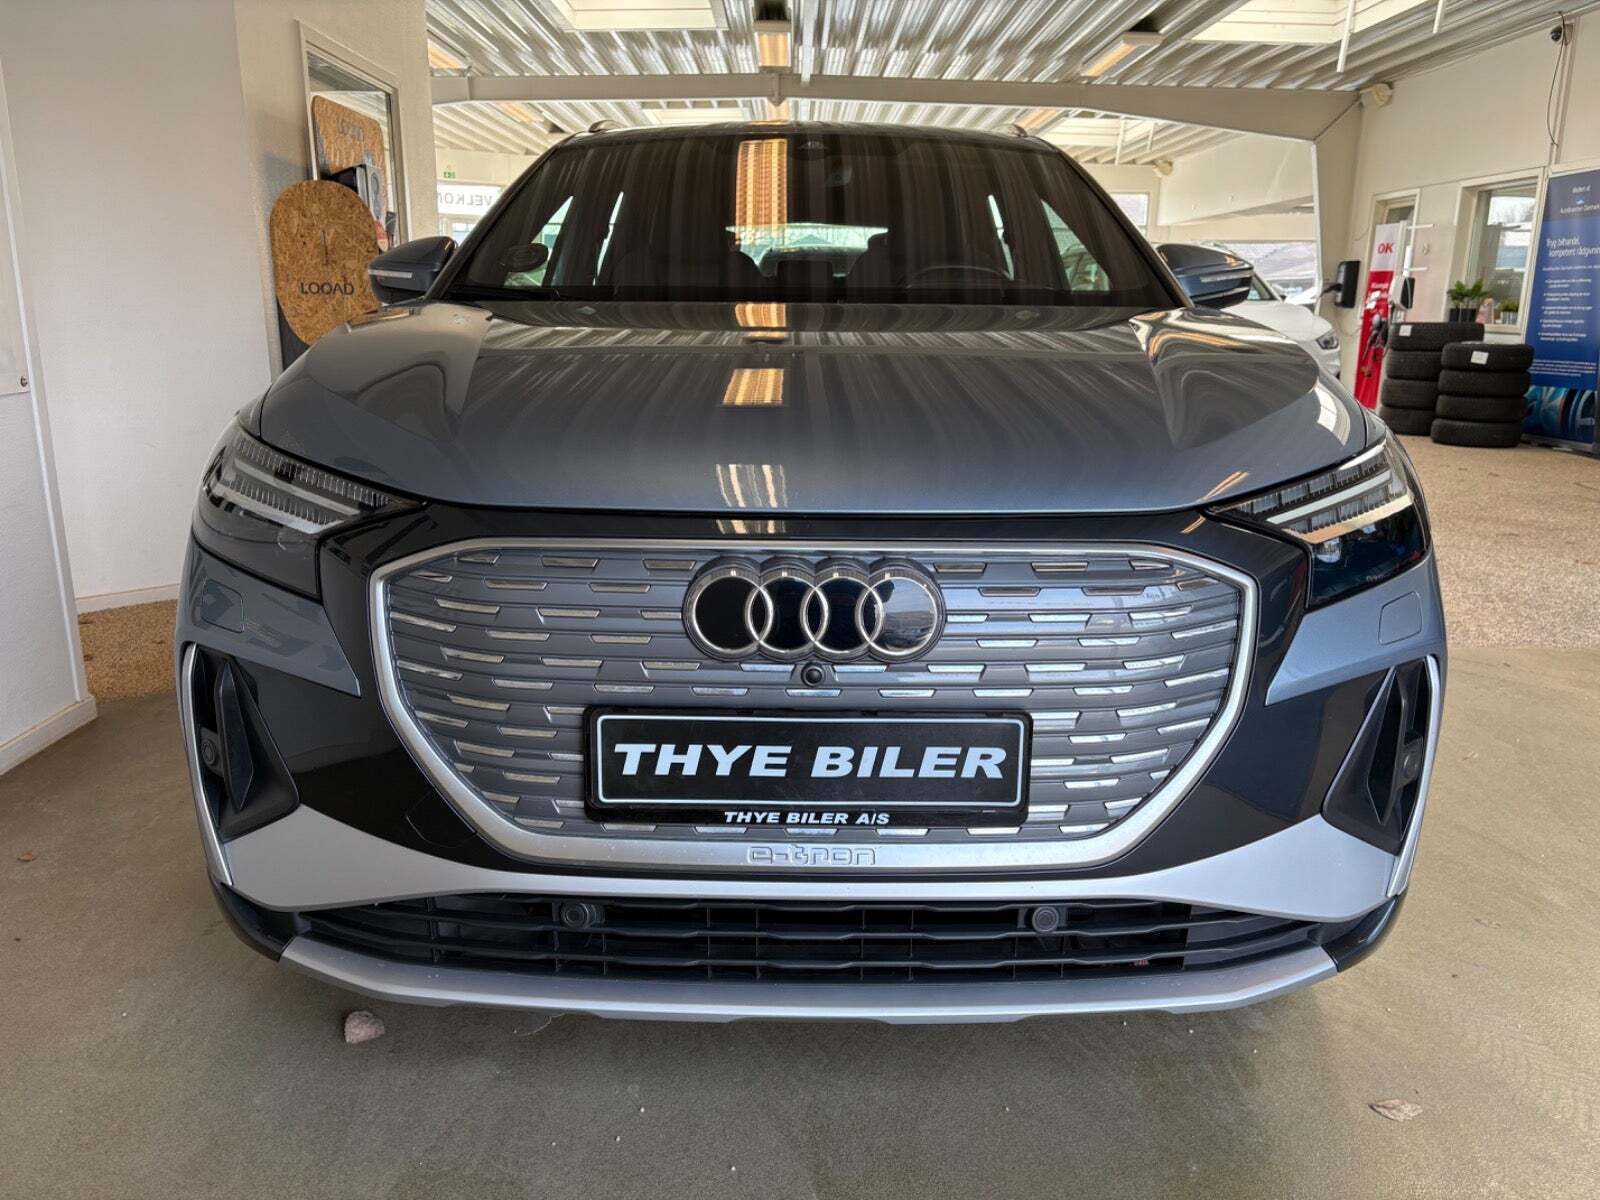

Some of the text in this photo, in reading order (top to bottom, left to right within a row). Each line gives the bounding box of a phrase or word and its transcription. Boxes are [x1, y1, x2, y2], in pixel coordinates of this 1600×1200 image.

[1377, 242, 1394, 254] OK
[614, 743, 1007, 780] THYE BILER
[724, 811, 891, 825] THYE BILER A/S
[746, 845, 877, 866] e-tron
